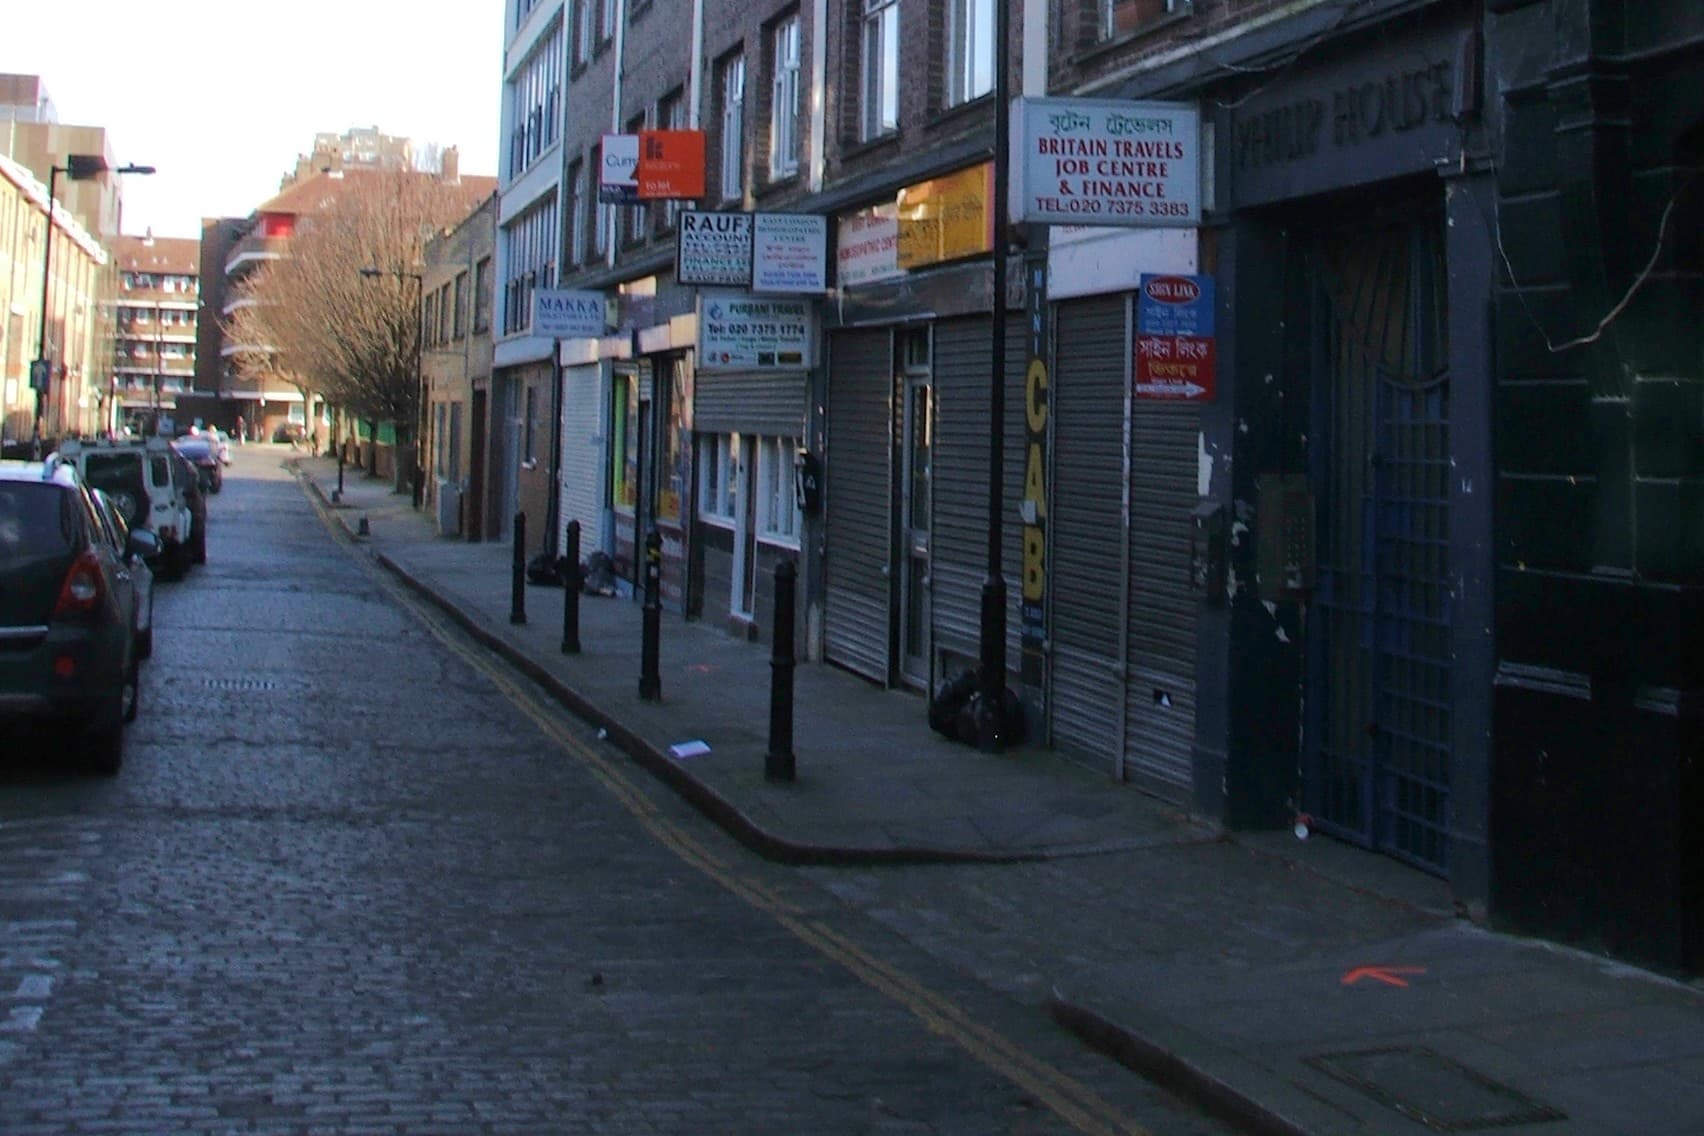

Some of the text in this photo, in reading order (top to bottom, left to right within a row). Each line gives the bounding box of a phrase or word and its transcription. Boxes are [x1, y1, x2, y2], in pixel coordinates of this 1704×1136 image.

[1332, 59, 1451, 147] HOUSE
[1038, 138, 1184, 159] BRITAIN TRAVELS
[1056, 159, 1168, 178] JOB CENTRE
[1059, 179, 1165, 198] & FINANCE
[1107, 200, 1144, 214] 7375
[1149, 201, 1189, 216] 3383
[685, 233, 750, 243] ACCOUNT
[1148, 282, 1171, 297] SIGN
[540, 297, 599, 313] MAKKA
[1033, 269, 1043, 356] MINI
[1022, 359, 1048, 601] CAB
